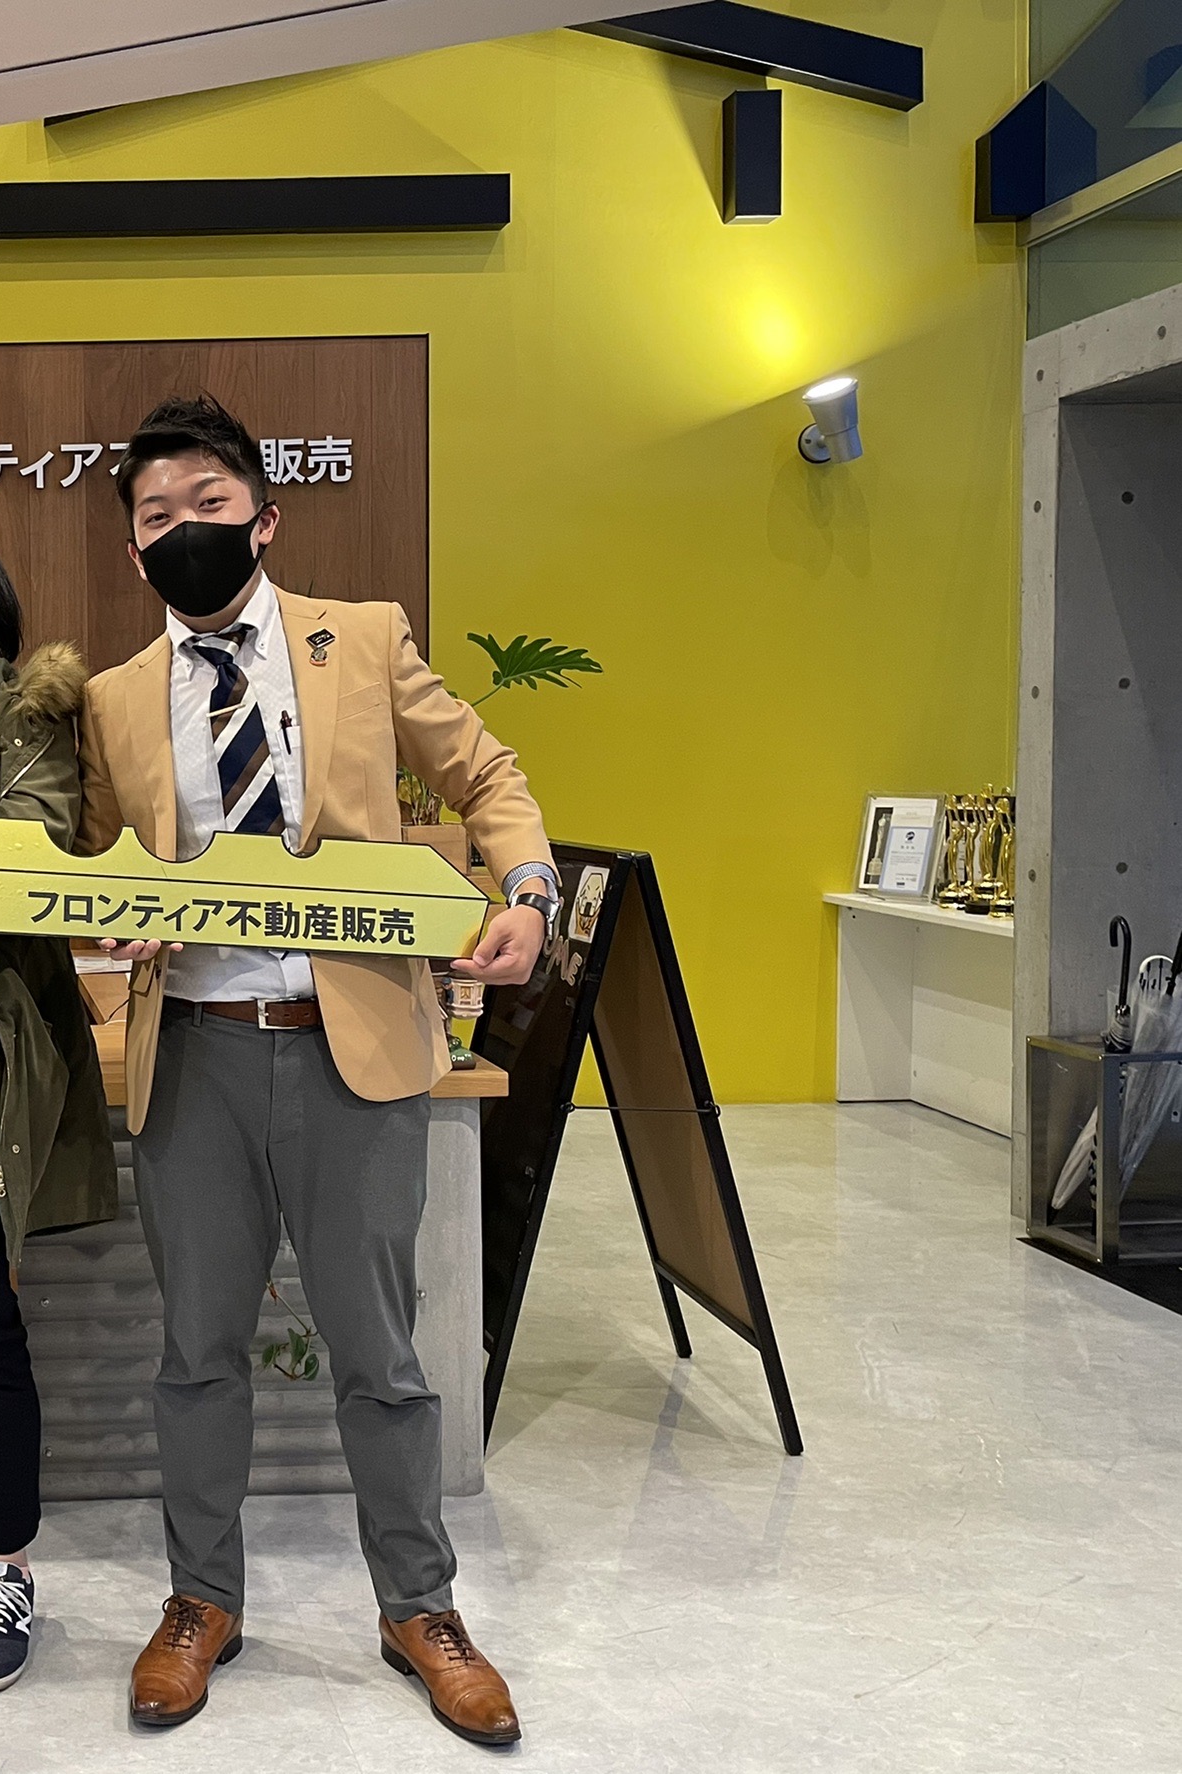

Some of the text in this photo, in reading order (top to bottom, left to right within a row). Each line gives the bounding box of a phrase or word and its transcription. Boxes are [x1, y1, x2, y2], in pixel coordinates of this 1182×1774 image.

[27, 890, 417, 946] フロンティア不動産販売
